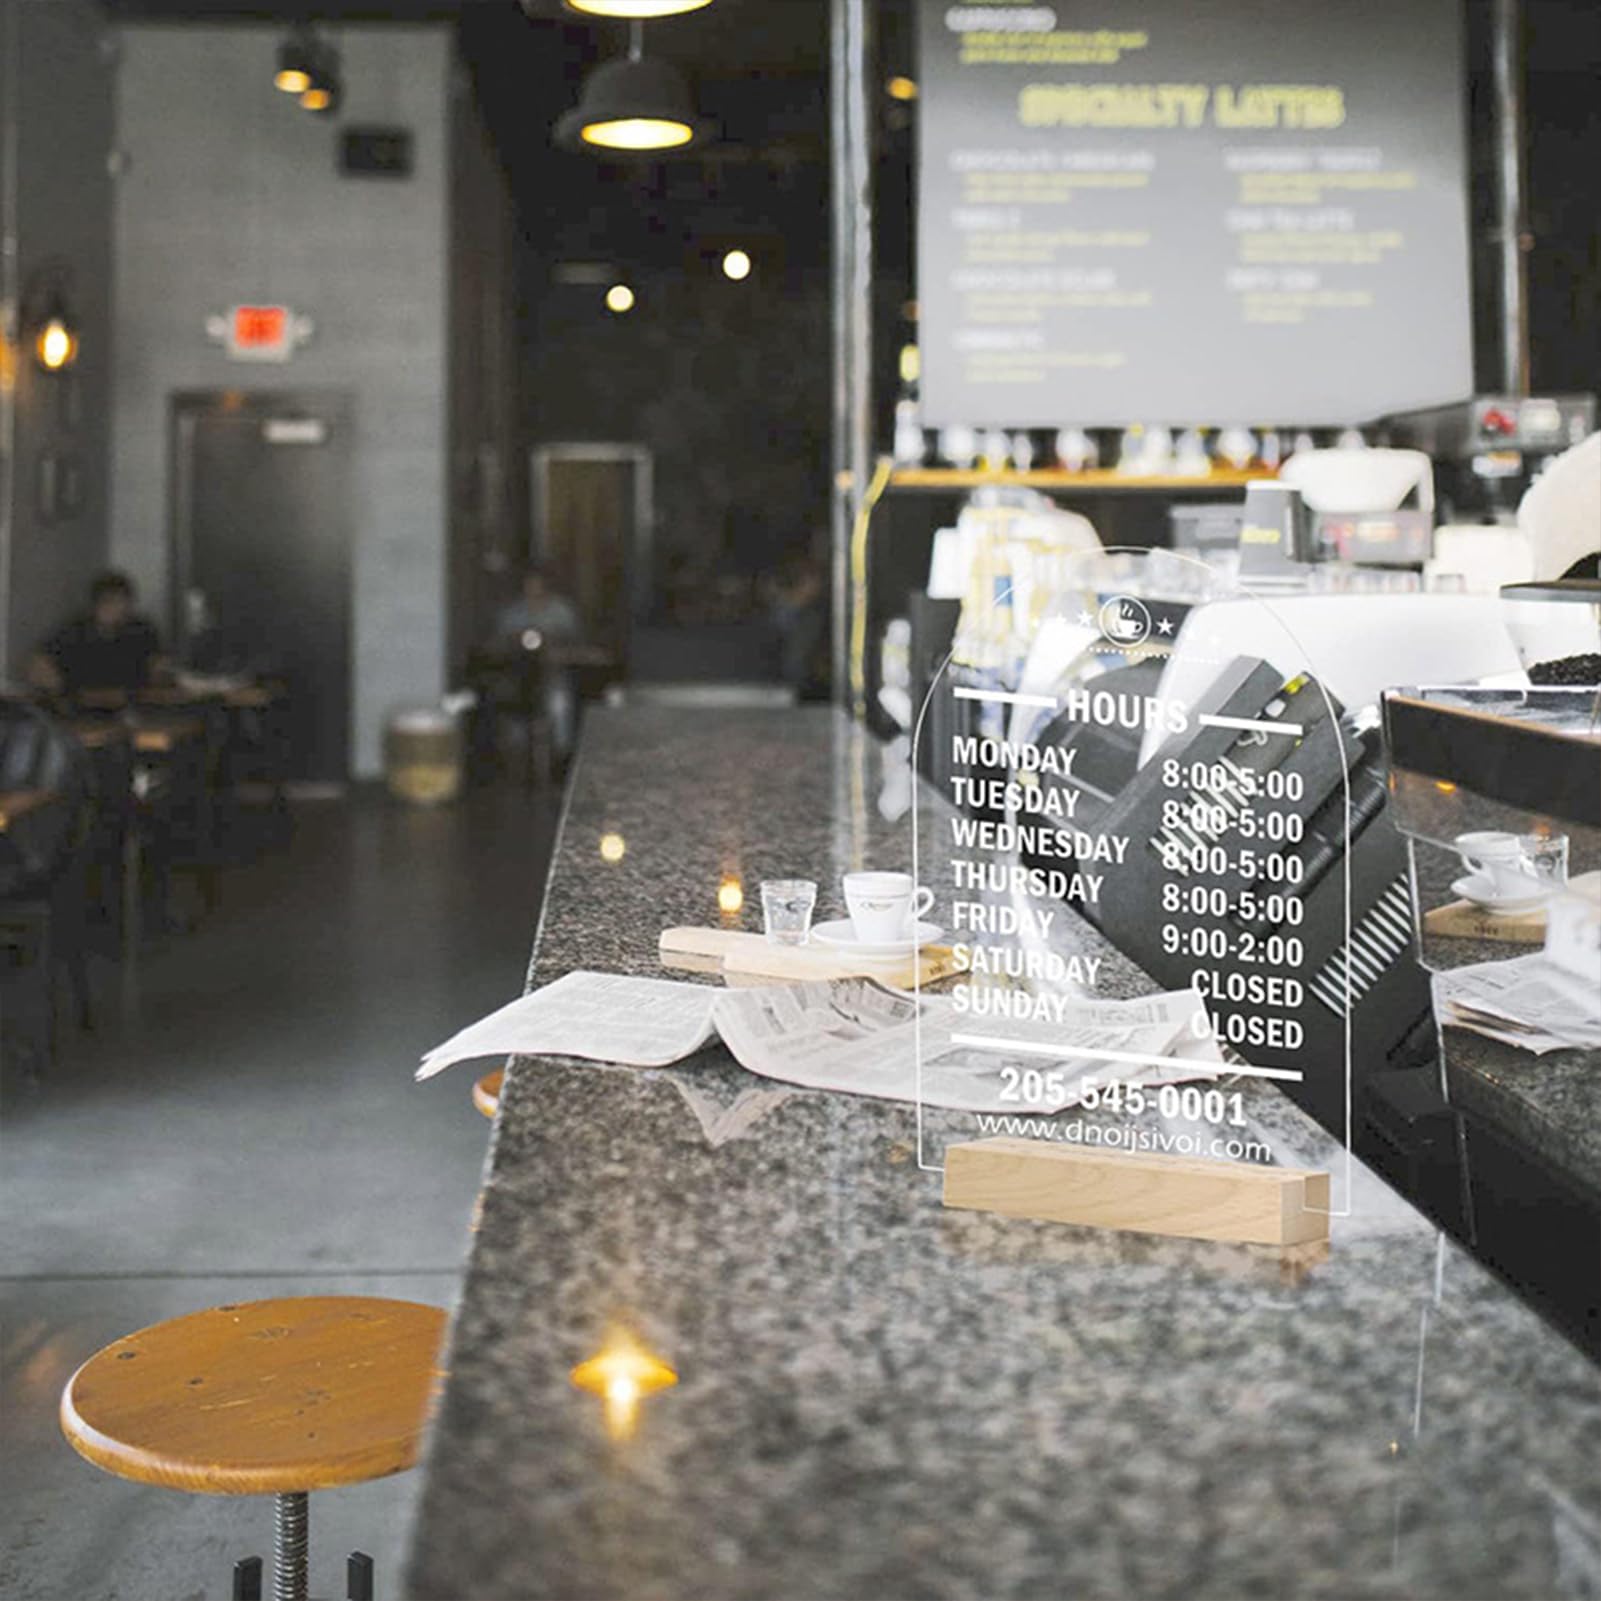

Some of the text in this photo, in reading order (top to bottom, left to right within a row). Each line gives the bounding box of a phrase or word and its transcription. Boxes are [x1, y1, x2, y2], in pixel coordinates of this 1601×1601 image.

[1067, 688, 1189, 734] HOURS
[952, 735, 1304, 802] MONDAY 8:00-5:00
[950, 775, 1304, 843] TUESDAY 8:00-5:00
[950, 817, 1304, 884] WEDNESDAY 8:00-5:00
[951, 859, 1304, 926] THURSDAY 8:00-5:00
[952, 901, 1304, 968] FRIDAY 9:00-2:00
[951, 942, 1304, 1009] SATURDAY CLOSED
[951, 983, 1067, 1024] SUNDAY
[1190, 1010, 1304, 1050] CLOSED
[999, 1066, 1247, 1127] 205-545-0001
[975, 1113, 1272, 1162] www.dnoijsivoi.com
